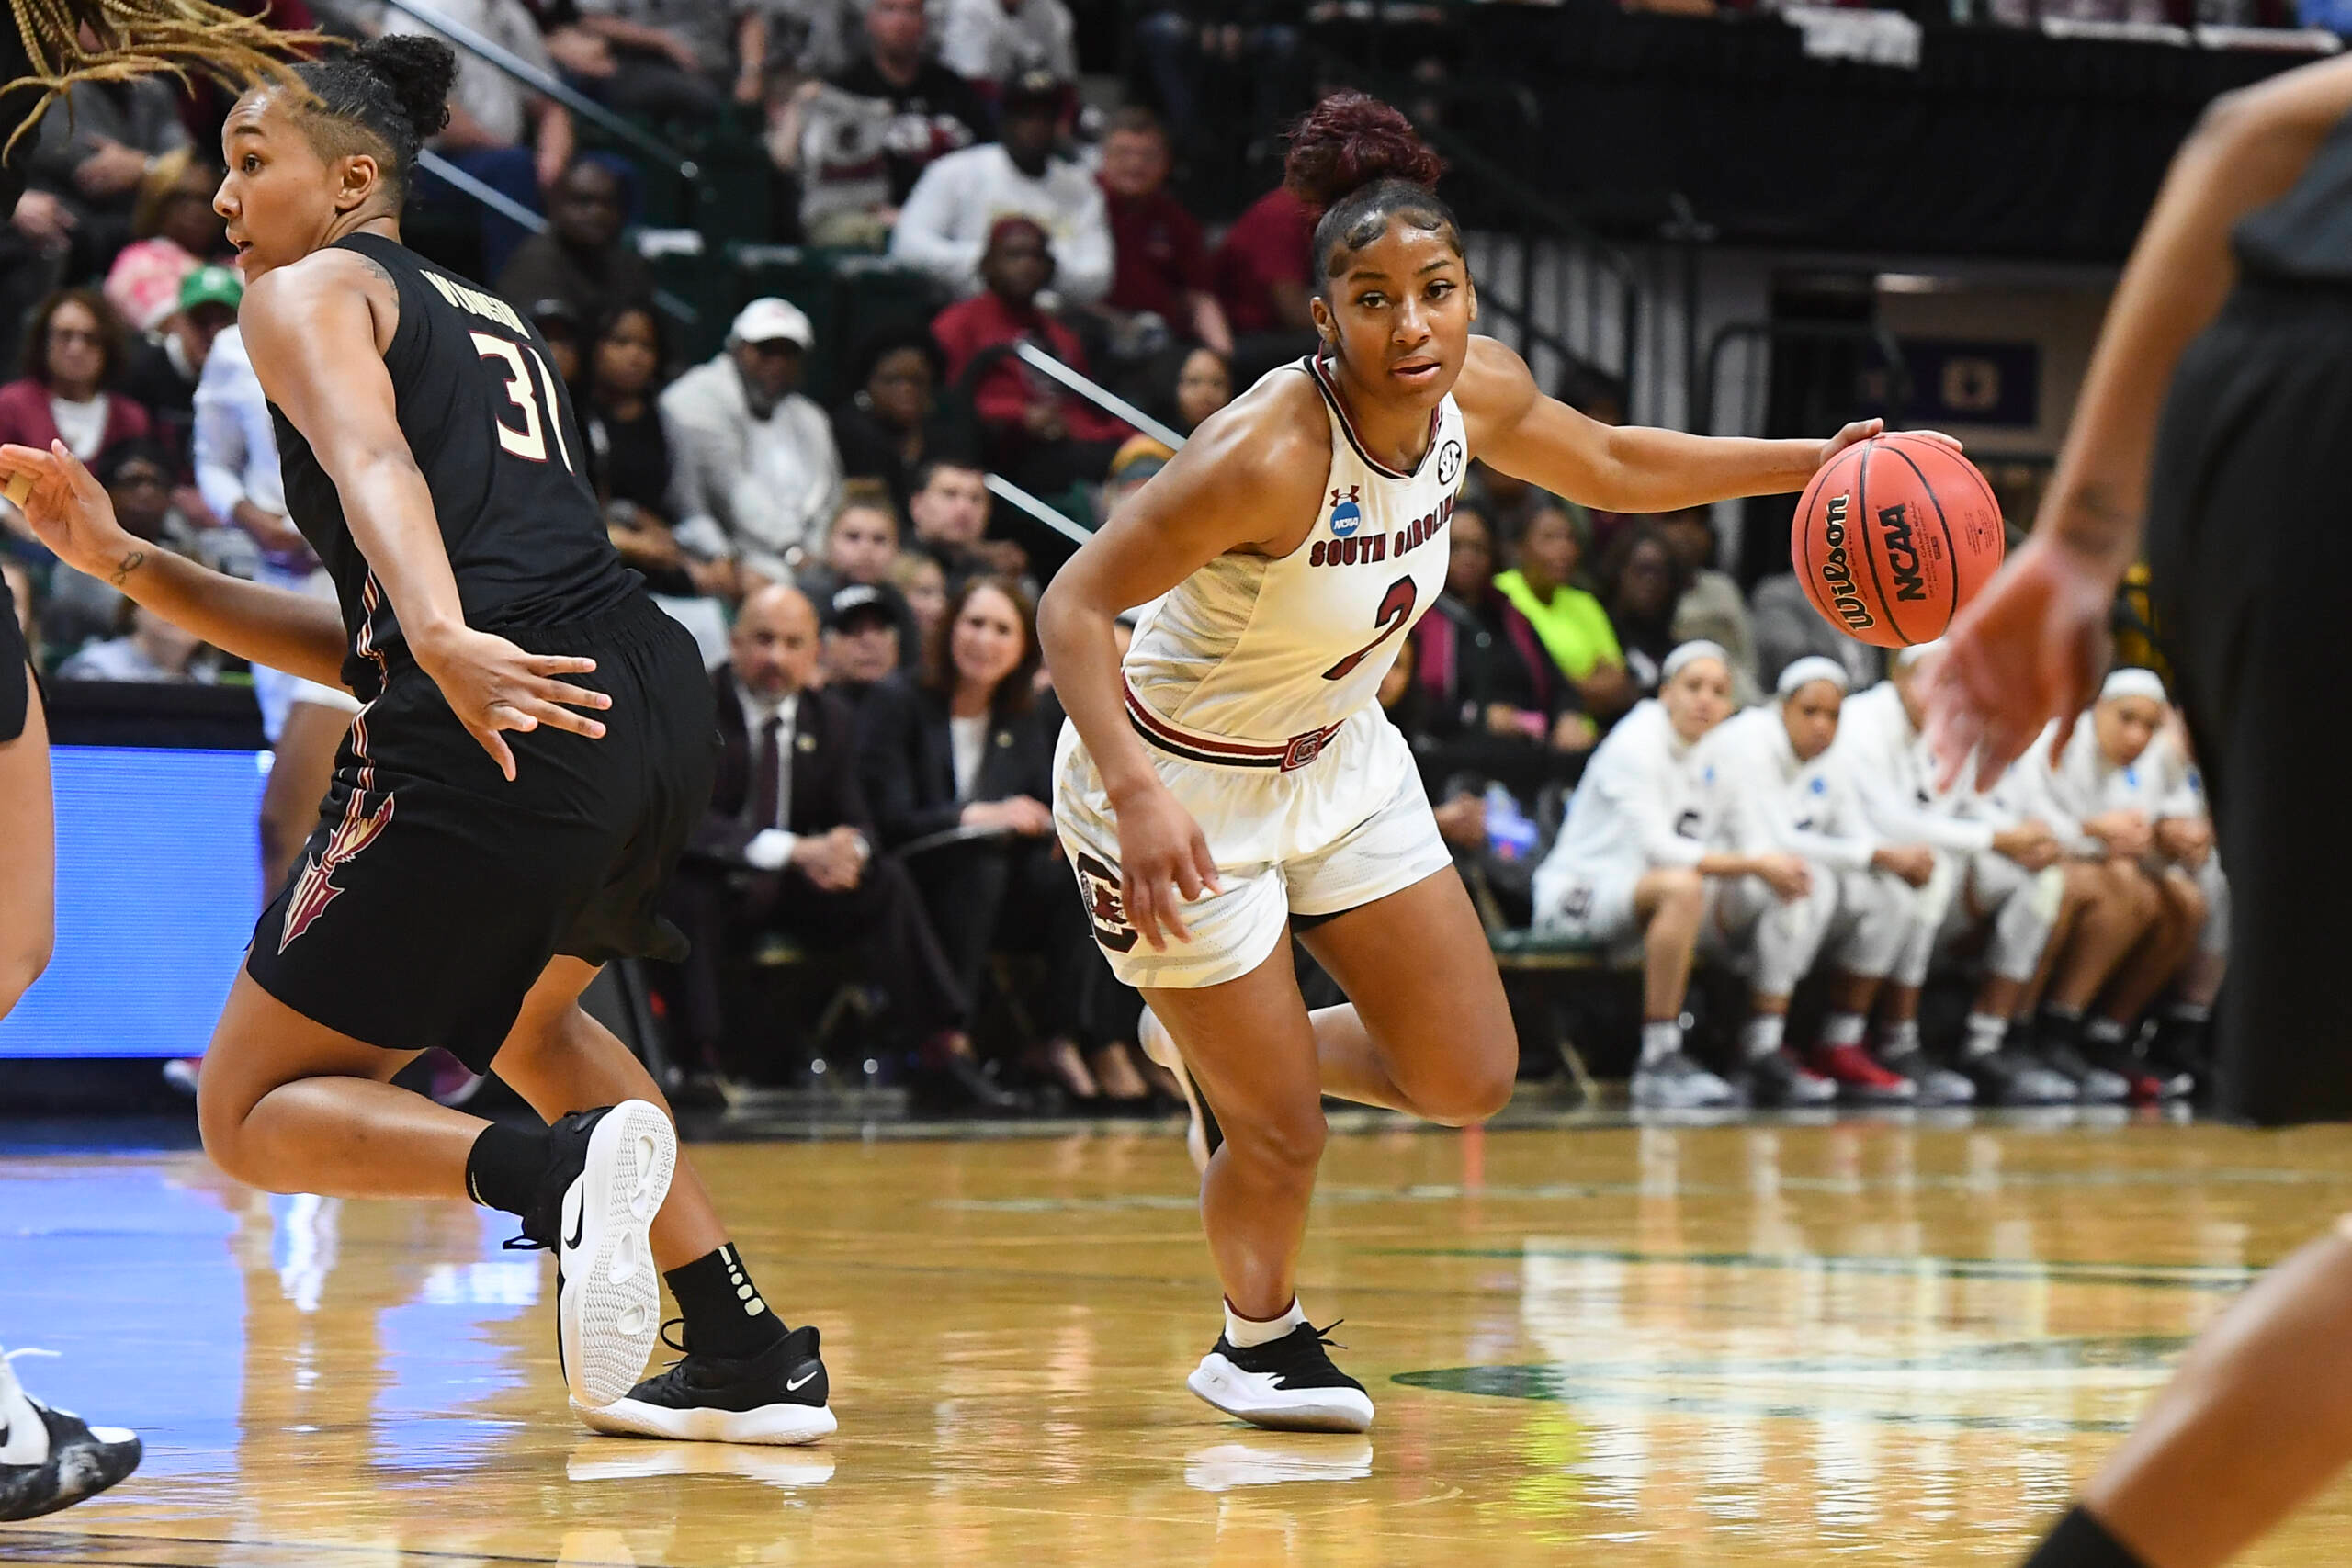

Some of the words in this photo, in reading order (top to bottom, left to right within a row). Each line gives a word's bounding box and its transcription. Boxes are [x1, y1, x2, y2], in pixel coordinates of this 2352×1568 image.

[469, 330, 575, 476] 31
[1309, 533, 1386, 567] SOUTH
[1394, 487, 1457, 558] CAROLIN
[1334, 517, 1359, 529] NCAA
[1822, 494, 1875, 631] Wilson
[1879, 503, 1926, 602] NCAA
[1321, 574, 1417, 680] 2
